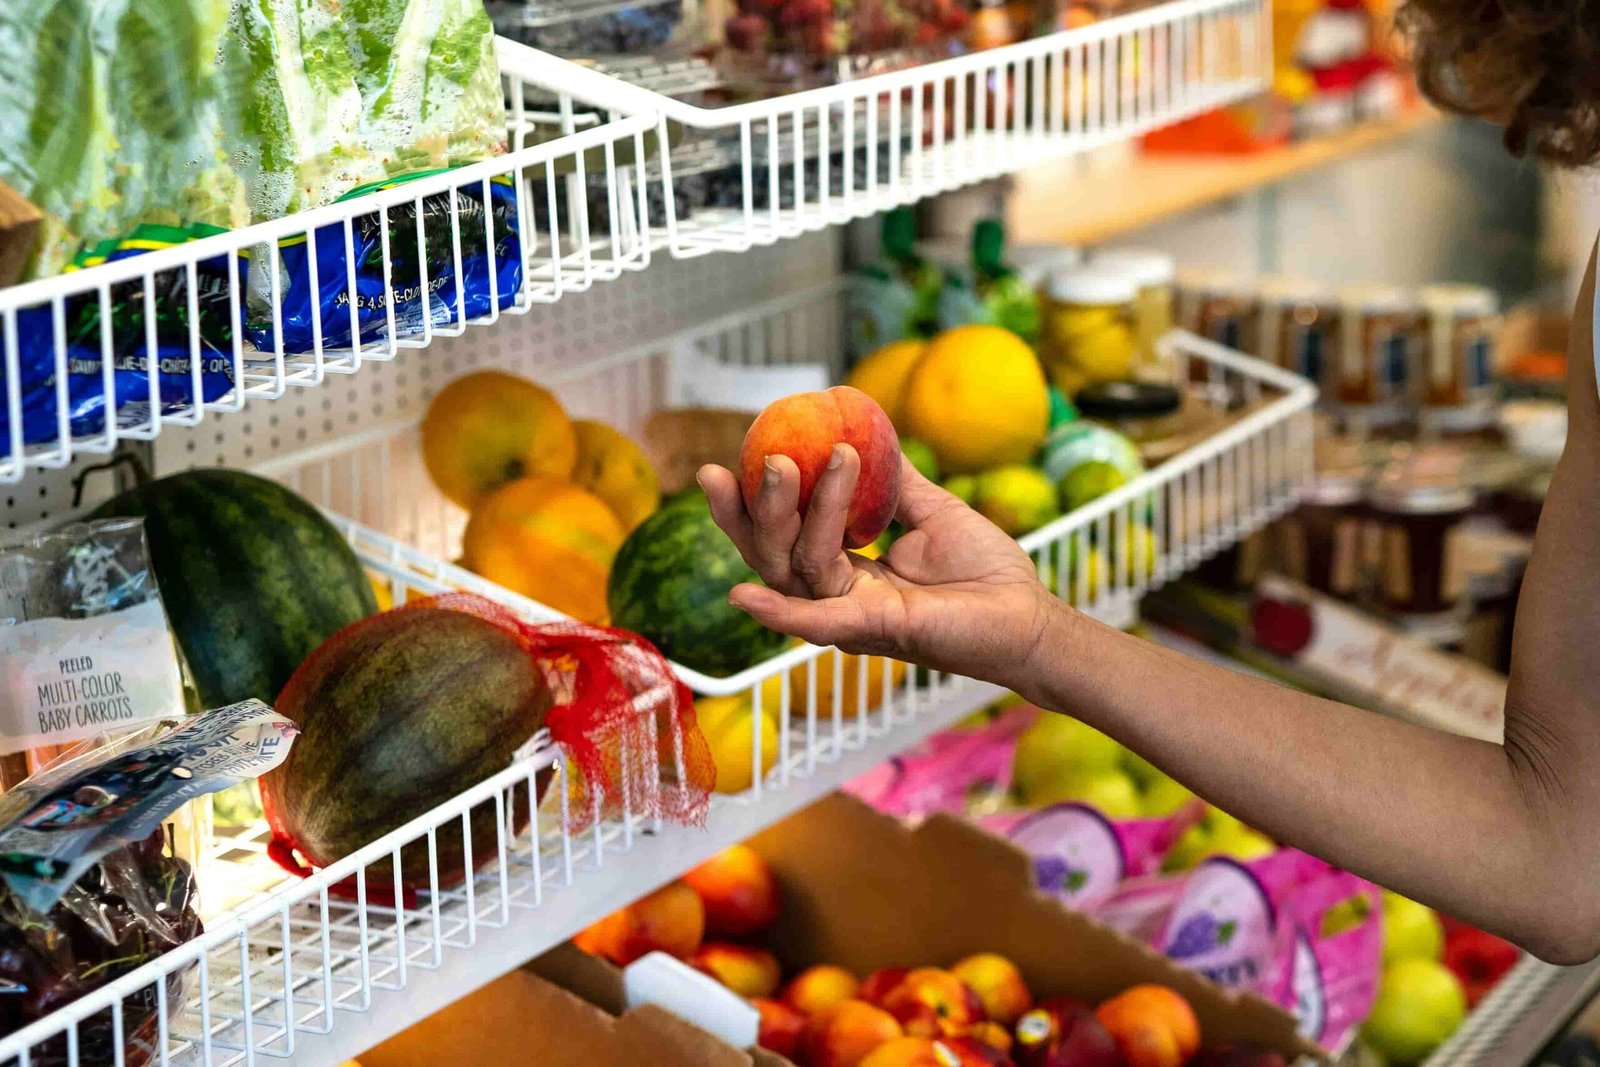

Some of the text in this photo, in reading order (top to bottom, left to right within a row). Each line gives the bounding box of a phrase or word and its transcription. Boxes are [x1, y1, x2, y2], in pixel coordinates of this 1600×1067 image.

[59, 656, 93, 675] PEELED
[37, 671, 125, 707] MULTI-COLOR
[38, 706, 71, 734] BABY
[75, 696, 133, 728] CARROTS
